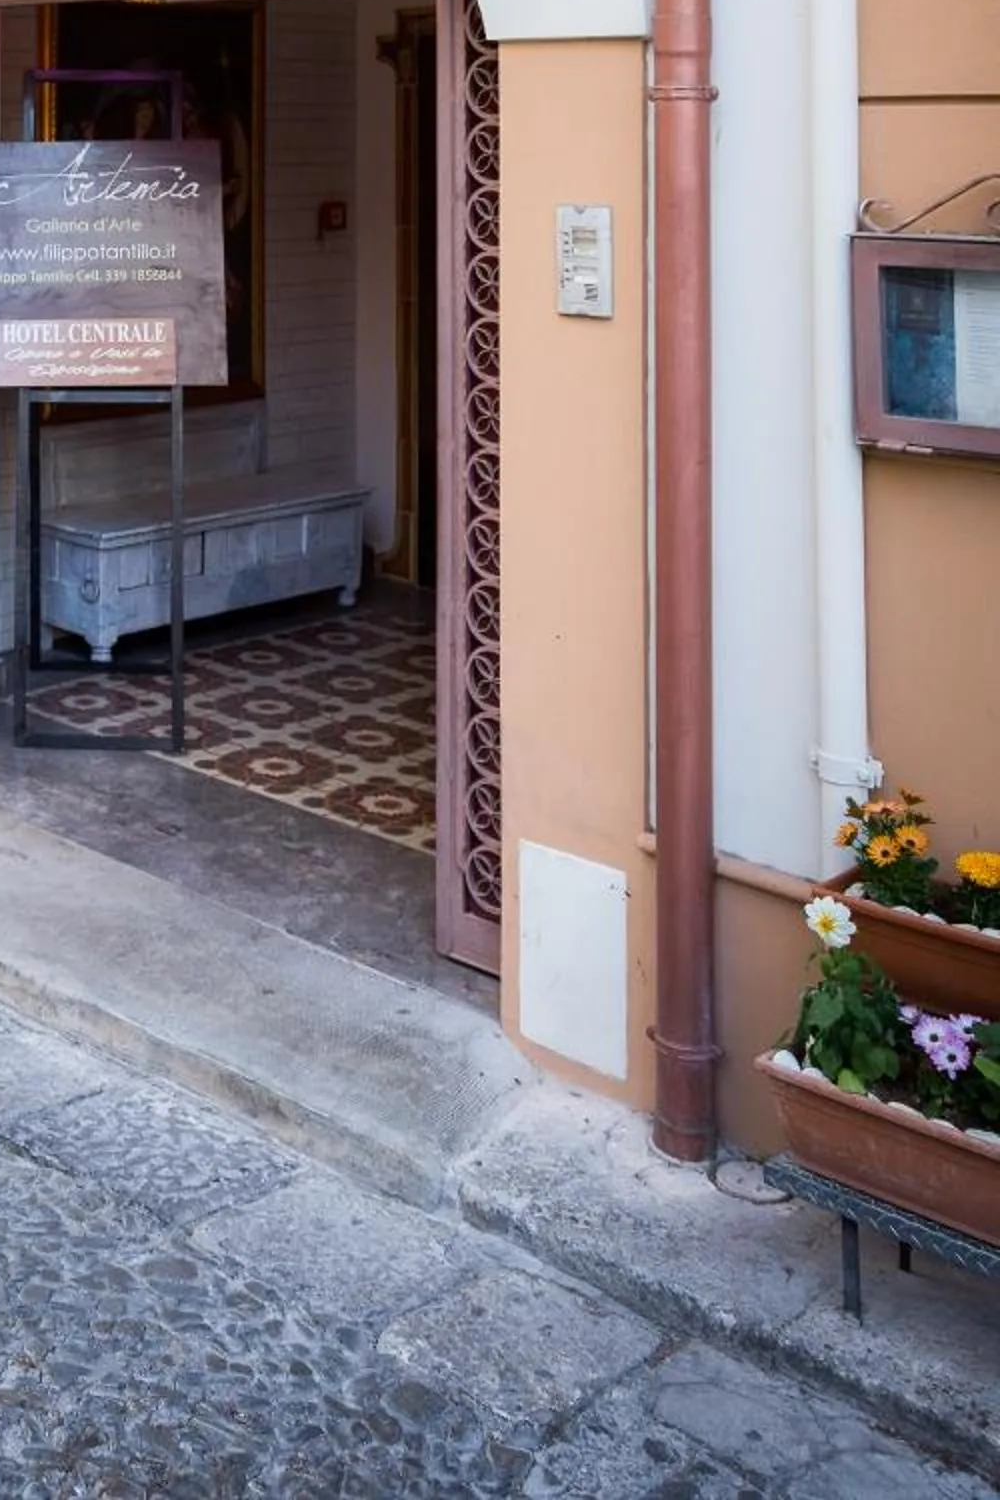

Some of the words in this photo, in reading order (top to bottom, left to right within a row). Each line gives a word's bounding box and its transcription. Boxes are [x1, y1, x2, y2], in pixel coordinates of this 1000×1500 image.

[25, 217, 89, 234] Galleria
[93, 216, 144, 233] d'Arte
[3, 323, 66, 344] HOTEL
[68, 321, 167, 343] CENTRALE
